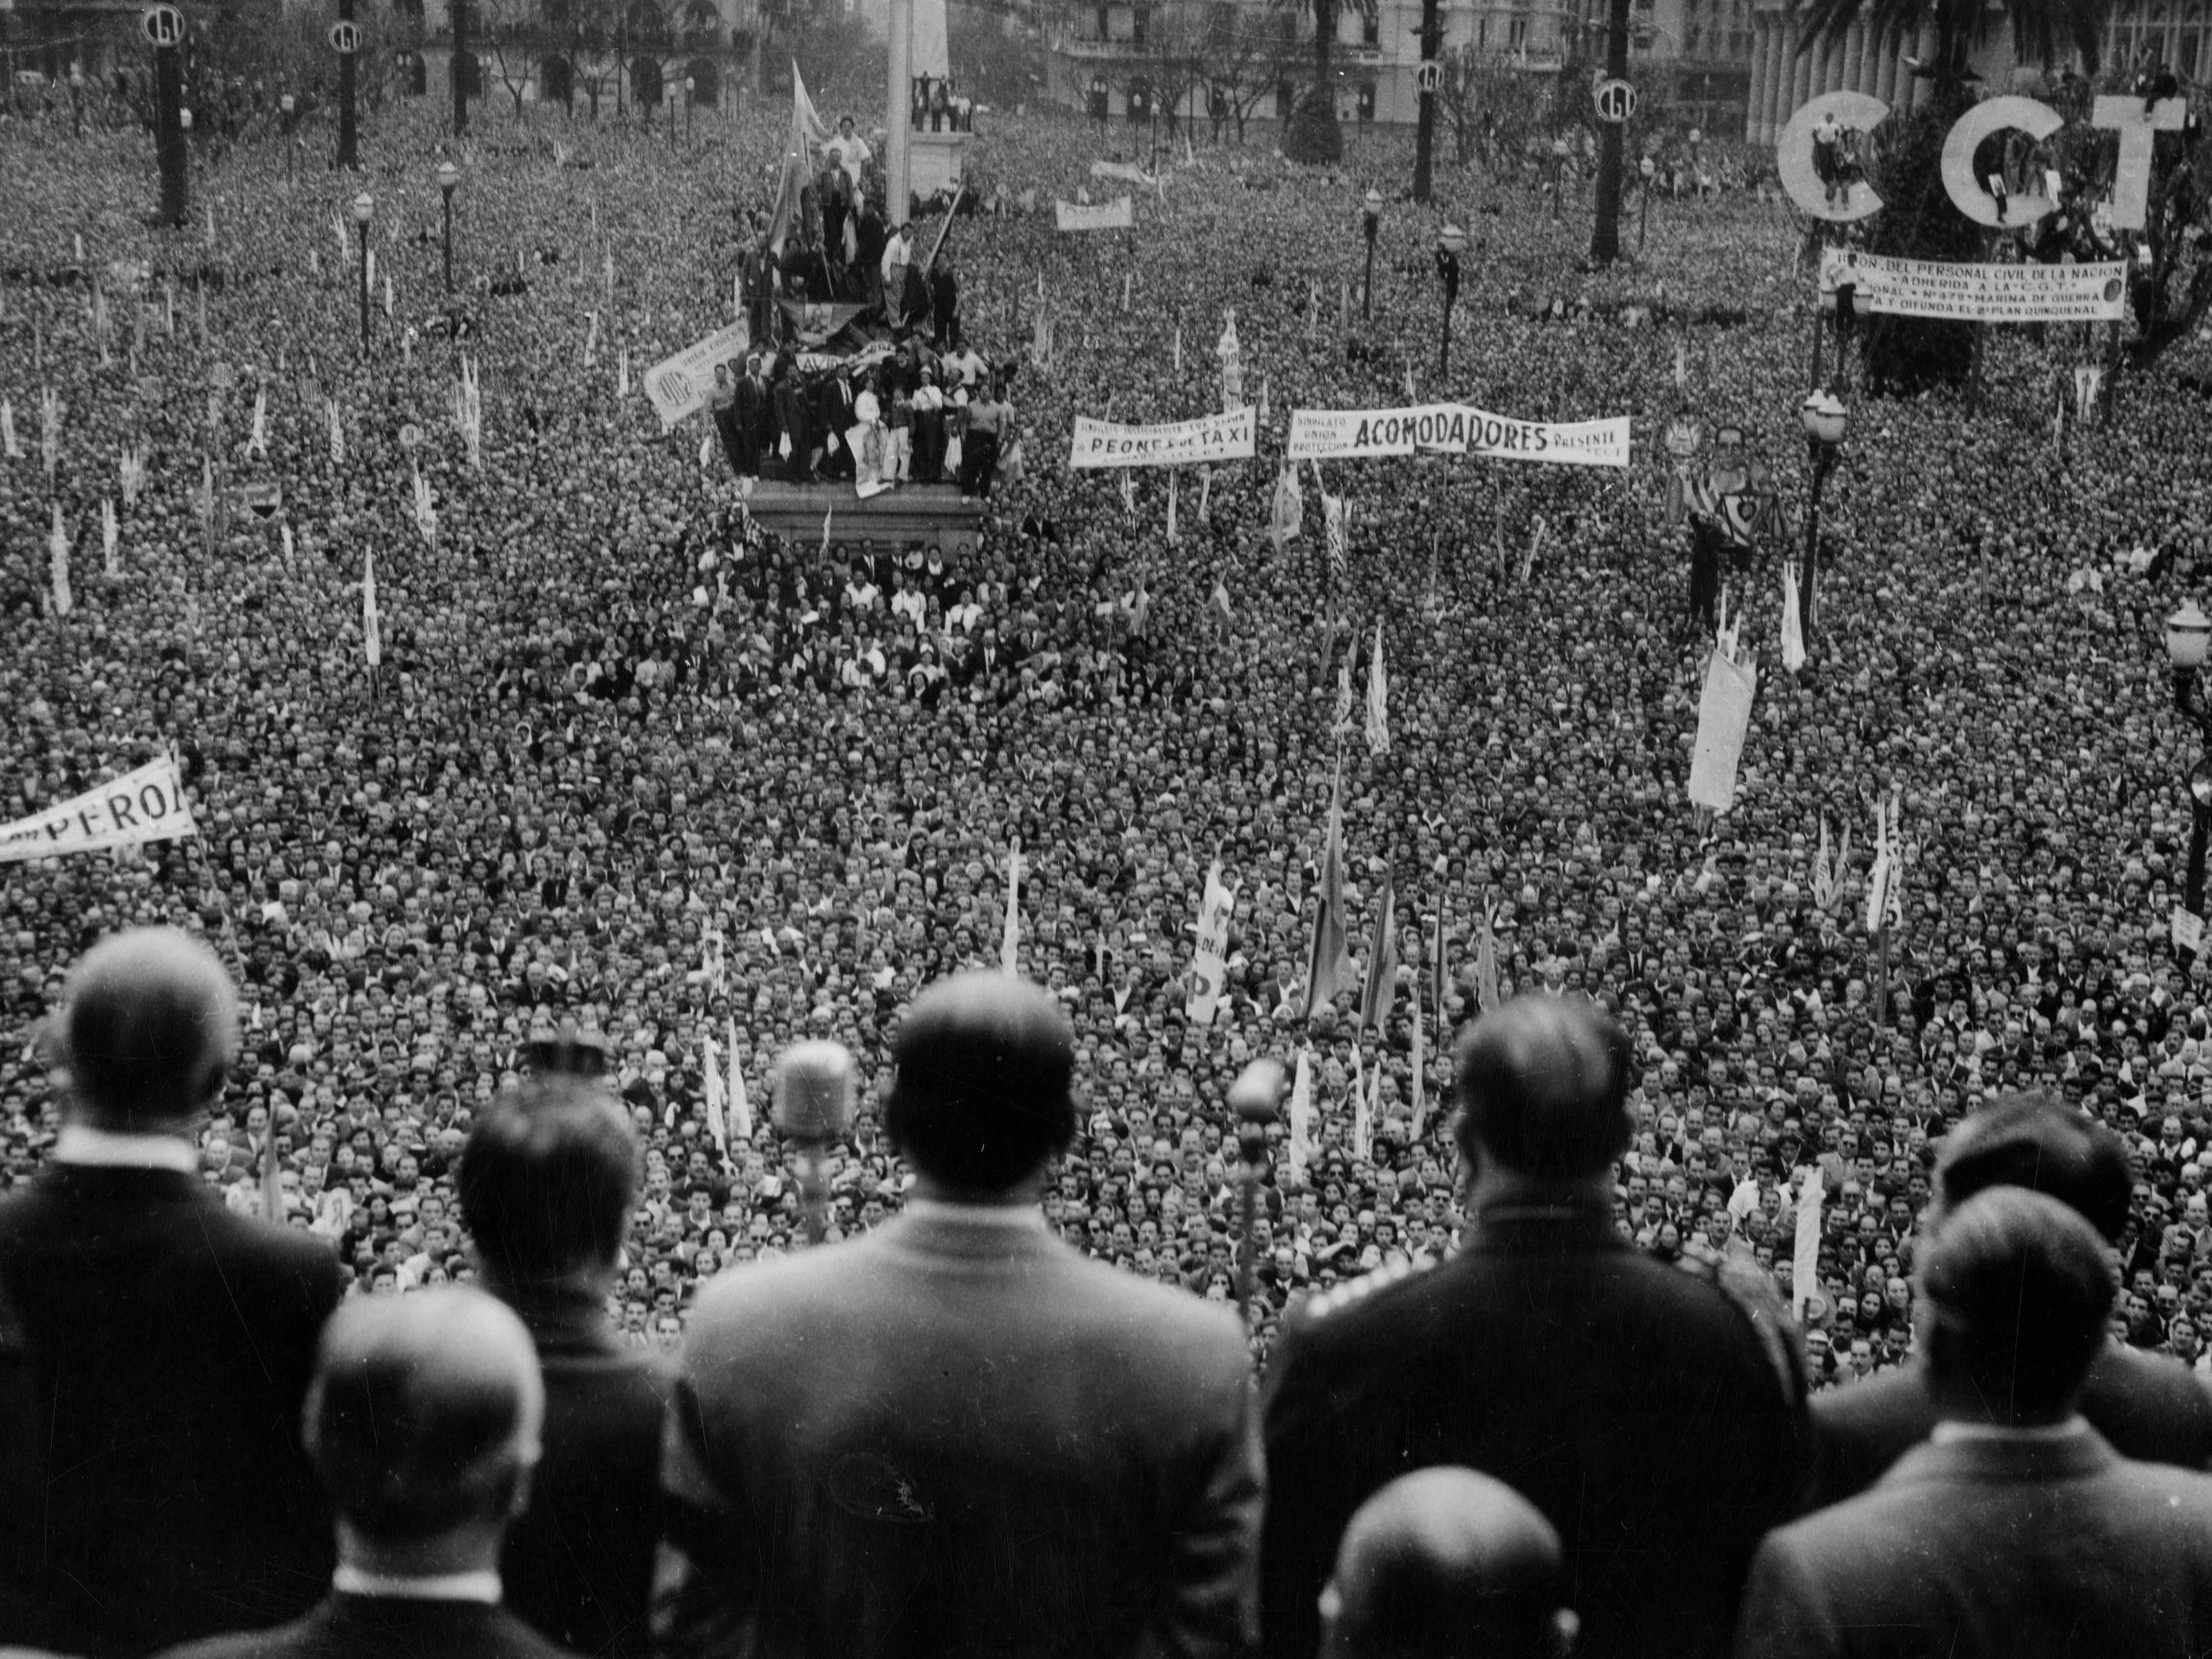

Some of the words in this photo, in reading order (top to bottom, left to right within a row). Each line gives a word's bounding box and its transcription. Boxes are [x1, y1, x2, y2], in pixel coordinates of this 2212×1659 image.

[1886, 260, 1910, 275] DEL
[1917, 261, 1988, 280] PERSONAL
[1994, 269, 2026, 281] CIVIL
[2032, 268, 2045, 281] DE
[2051, 268, 2065, 280] LA
[2072, 265, 2123, 280] NACION
[1902, 275, 1969, 291] ADHERIDA
[1979, 282, 1986, 291] A
[1975, 294, 2026, 304] MARINA
[1900, 300, 1954, 313] DIFUNDA
[2026, 305, 2097, 316] QUINQUENAL
[1201, 427, 1248, 445] TAXI
[1304, 429, 1337, 440] UNION
[1354, 413, 1548, 451] ACOMODADORES
